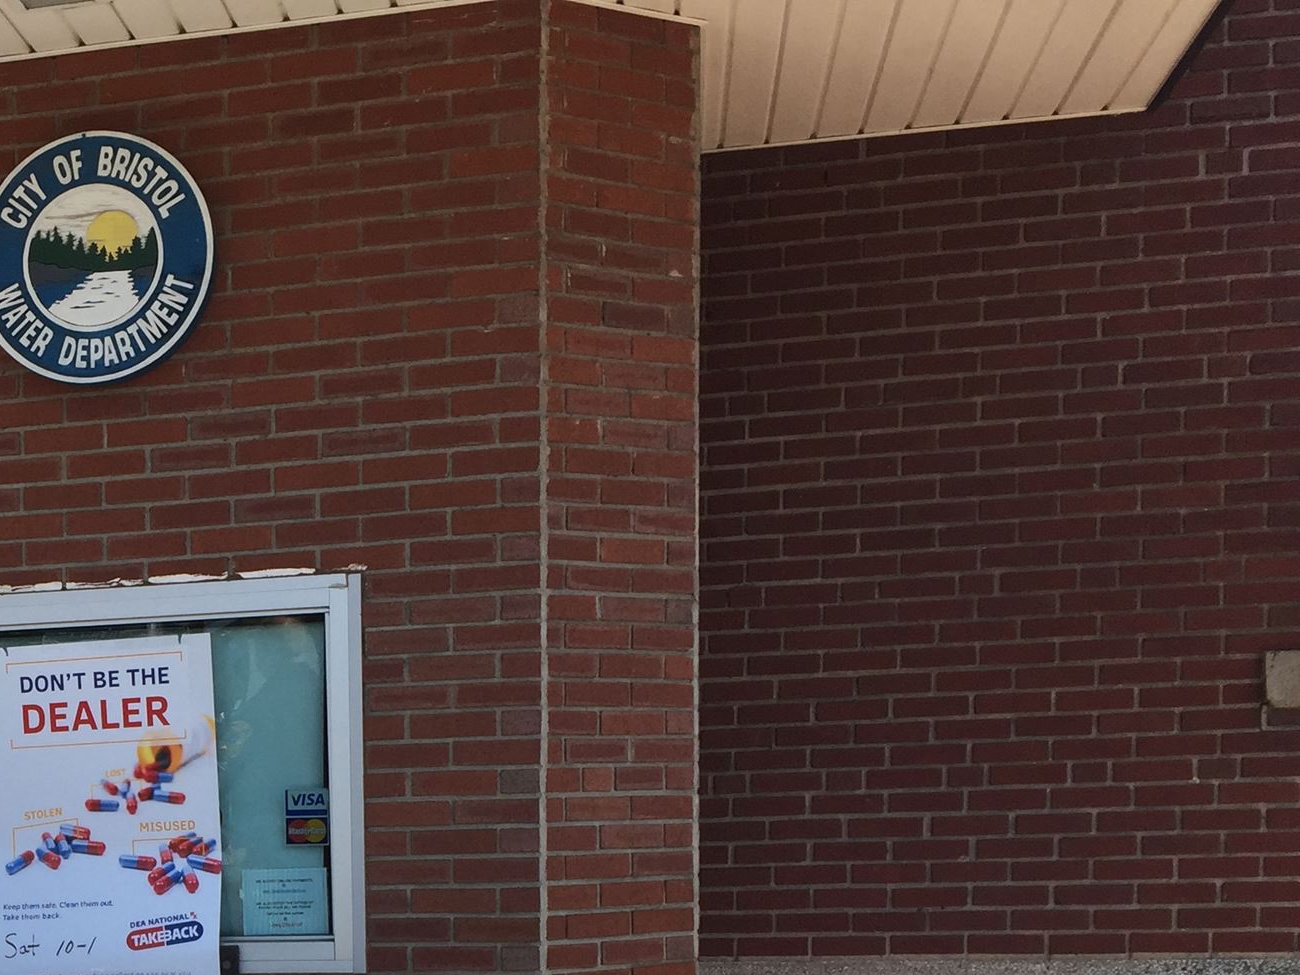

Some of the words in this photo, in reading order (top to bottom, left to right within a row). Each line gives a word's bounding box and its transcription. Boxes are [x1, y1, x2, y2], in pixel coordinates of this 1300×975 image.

[0, 173, 47, 229] CITY
[53, 149, 82, 185] OF
[97, 145, 186, 219] BRISTOL
[58, 274, 195, 369] DEPARTMENT
[19, 672, 86, 693] DON'T
[93, 670, 120, 688] BE
[126, 666, 170, 686] THE
[22, 695, 170, 734] DEALER
[105, 768, 126, 777] LOST
[291, 793, 325, 806] VISA
[23, 807, 63, 820] STOLEN
[139, 820, 196, 832] MISUSED
[3, 903, 21, 911] Keep
[129, 920, 146, 928] DEA
[148, 913, 189, 925] NATIONAL
[4, 932, 40, 959] Sat
[56, 936, 97, 956] 10-1
